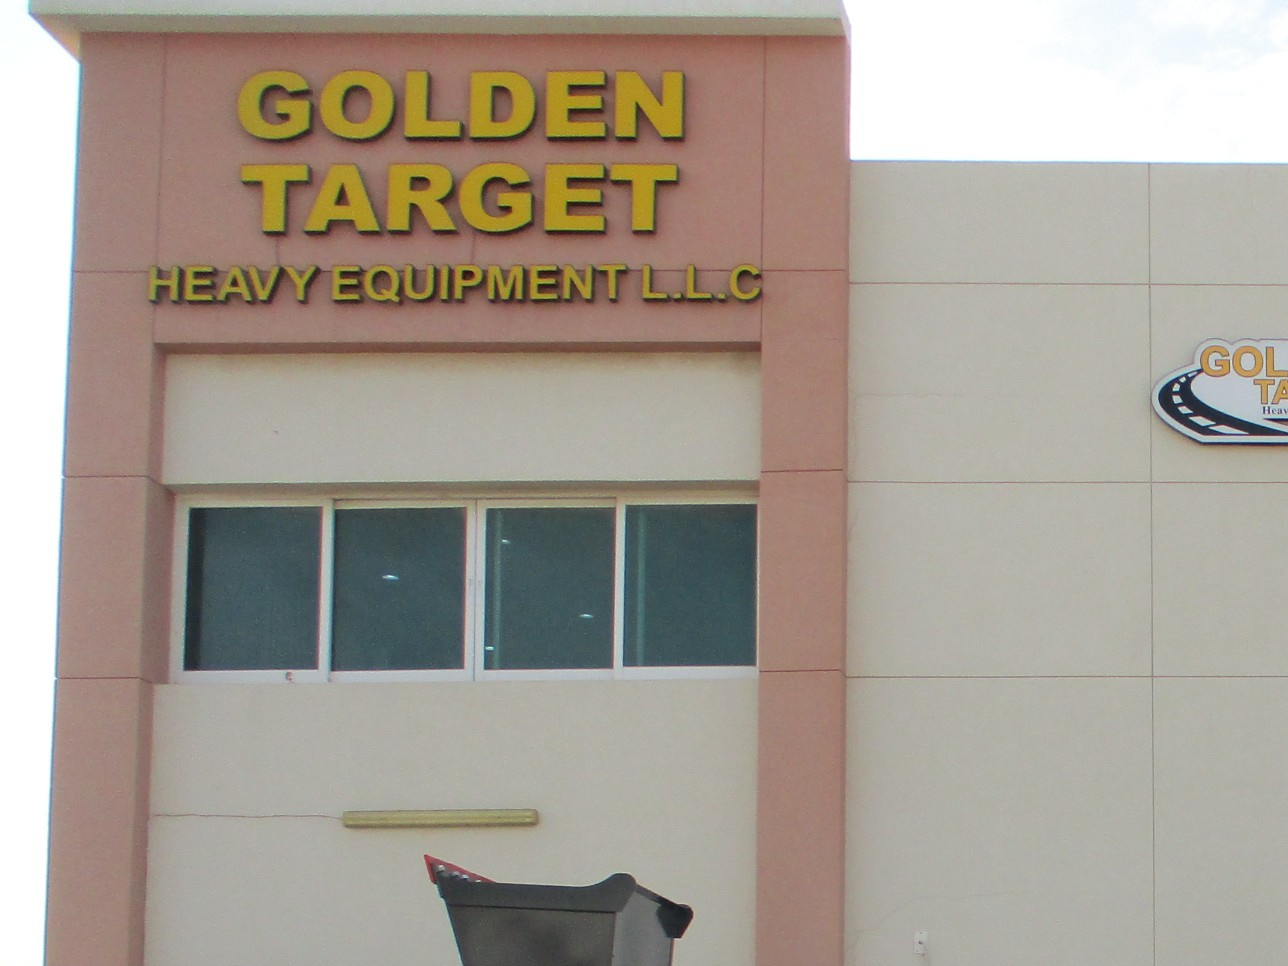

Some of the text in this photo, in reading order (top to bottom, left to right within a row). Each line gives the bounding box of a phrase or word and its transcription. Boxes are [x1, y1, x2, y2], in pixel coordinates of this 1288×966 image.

[237, 69, 685, 141] GOLDEN
[240, 162, 679, 235] TARGET
[148, 263, 763, 304] HEAVY EQUIPMENT L.L.C
